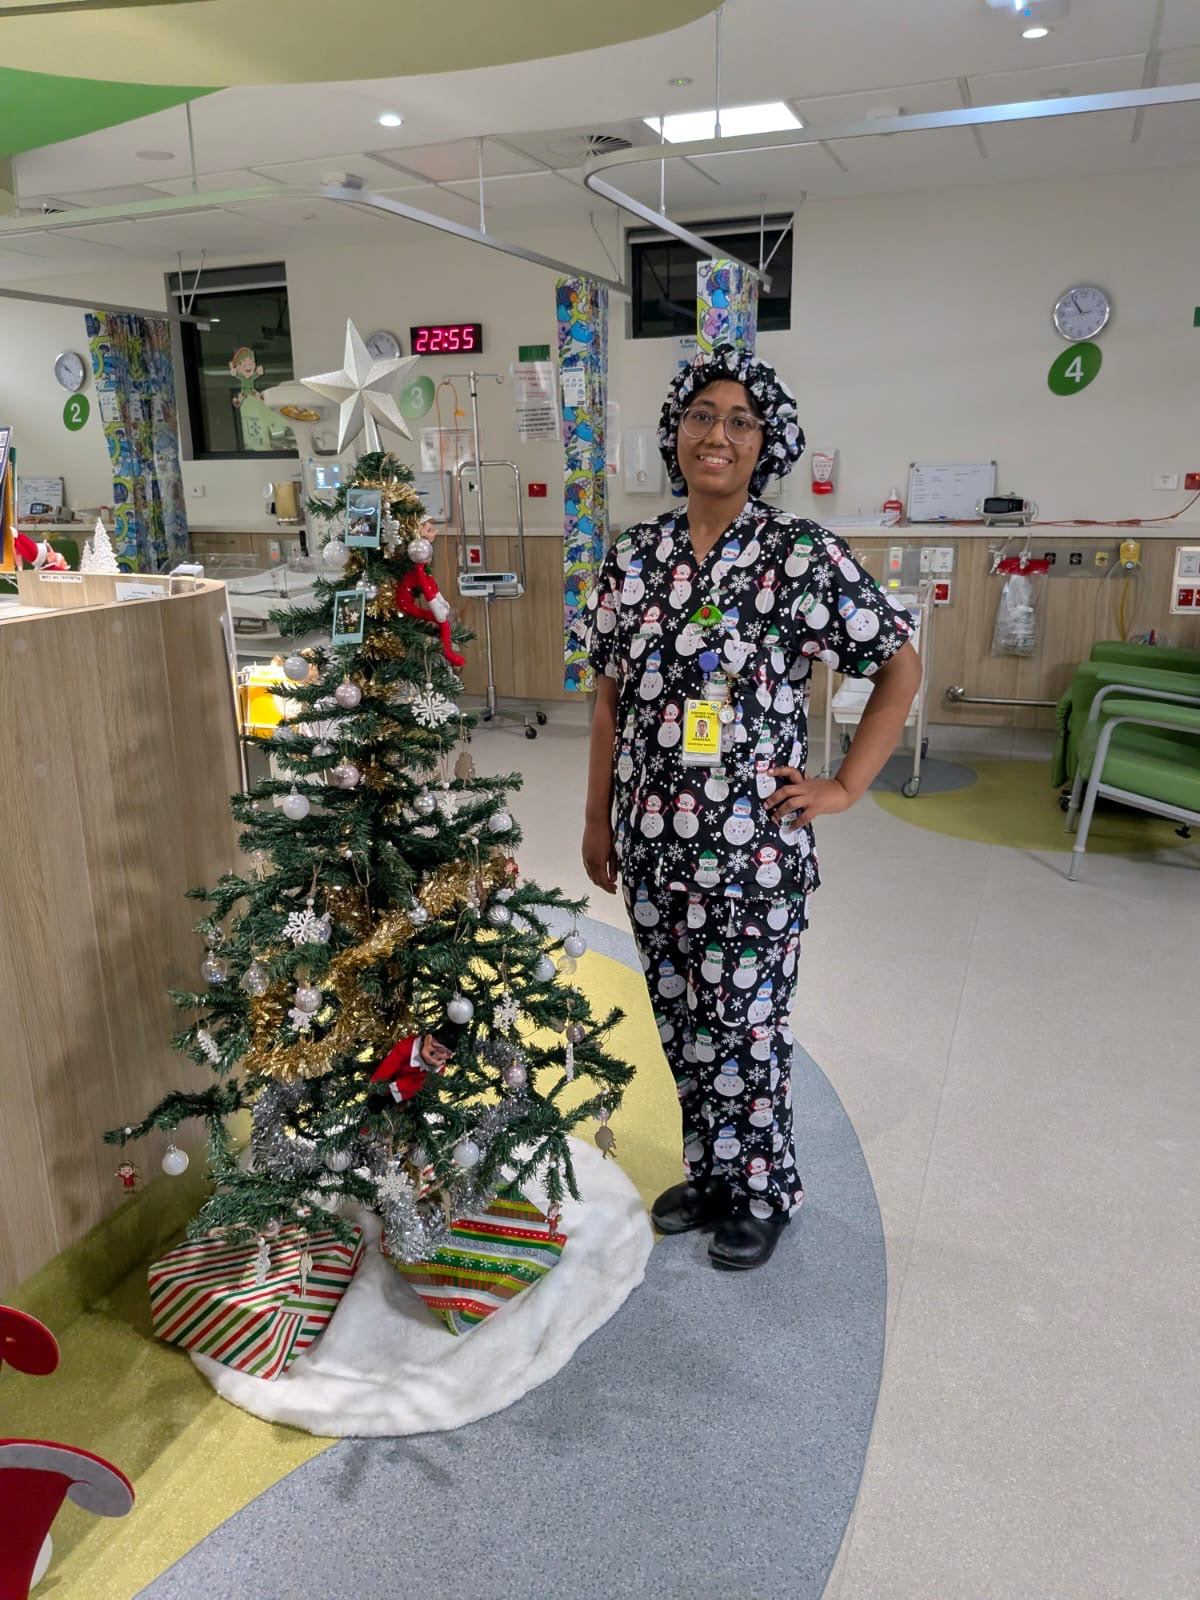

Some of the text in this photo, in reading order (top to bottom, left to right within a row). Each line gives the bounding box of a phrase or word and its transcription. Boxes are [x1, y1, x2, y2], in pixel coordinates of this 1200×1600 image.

[416, 327, 474, 352] 22:55
[1064, 355, 1084, 383] 4
[410, 386, 424, 409] 3
[70, 402, 82, 423] 2
